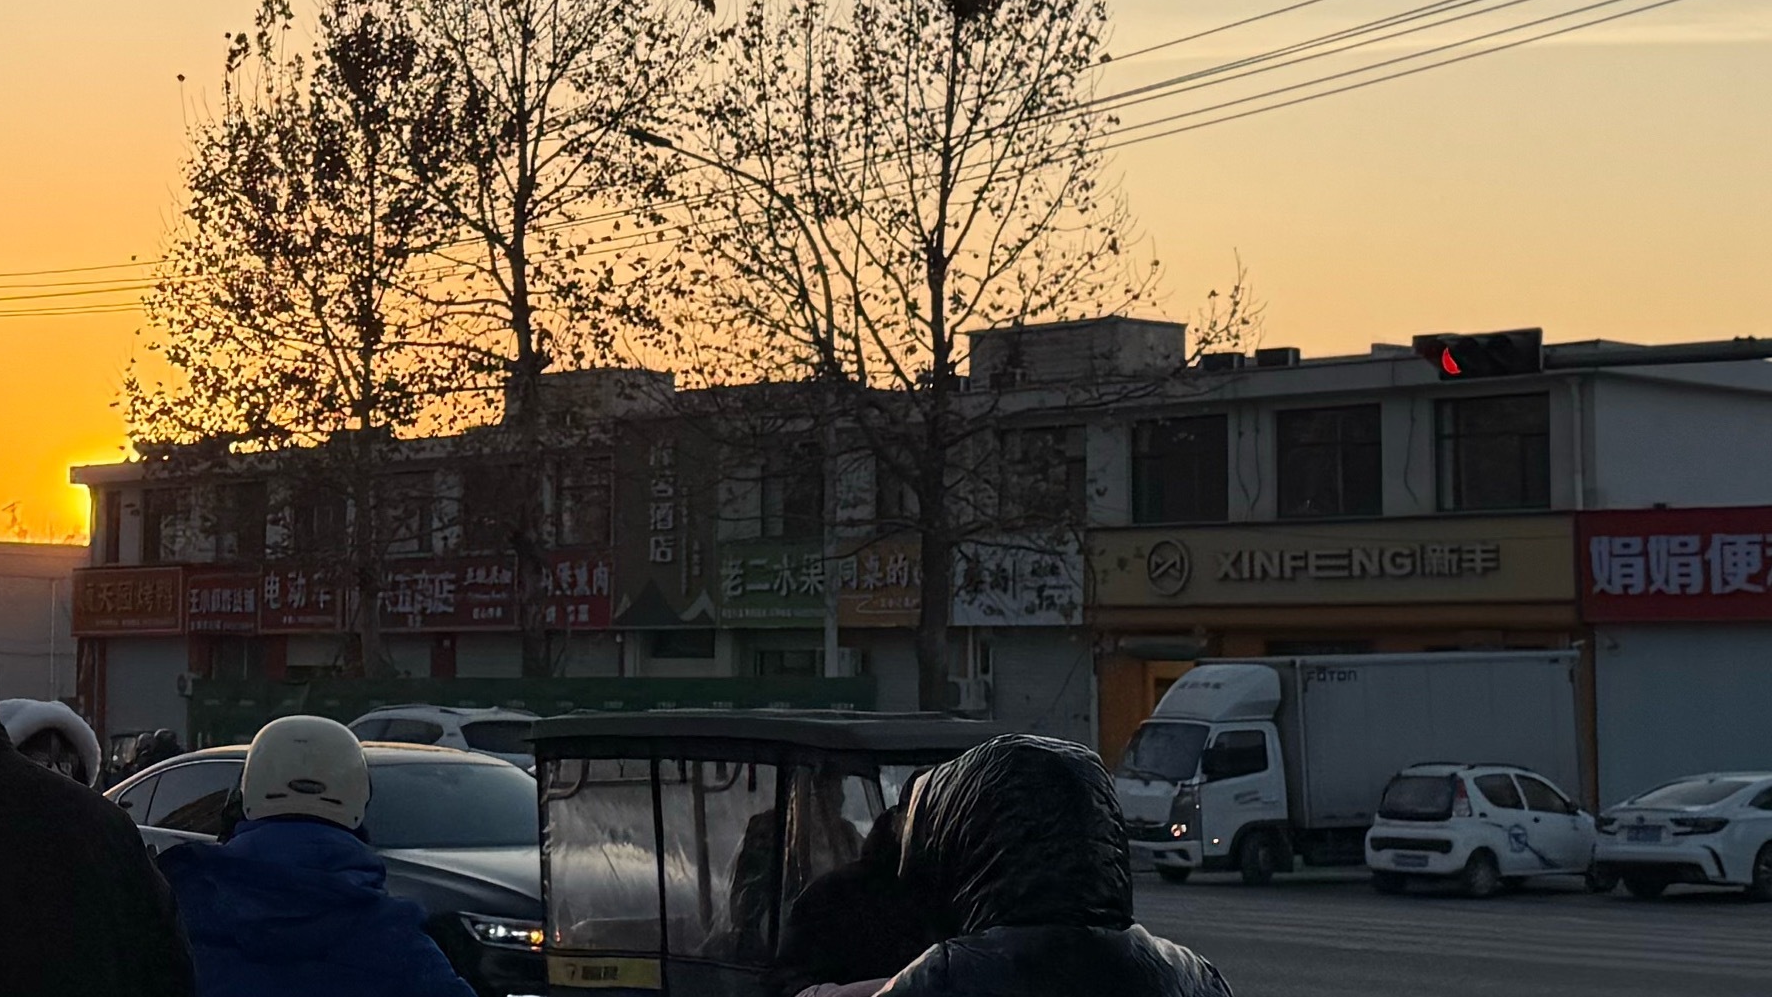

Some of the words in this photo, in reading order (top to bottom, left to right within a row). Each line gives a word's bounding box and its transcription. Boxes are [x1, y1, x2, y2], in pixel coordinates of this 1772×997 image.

[719, 552, 825, 597] 老二水果
[1217, 546, 1416, 580] XINFENG
[1424, 543, 1501, 575] 新丰
[1589, 533, 1772, 596] 娟娟便
